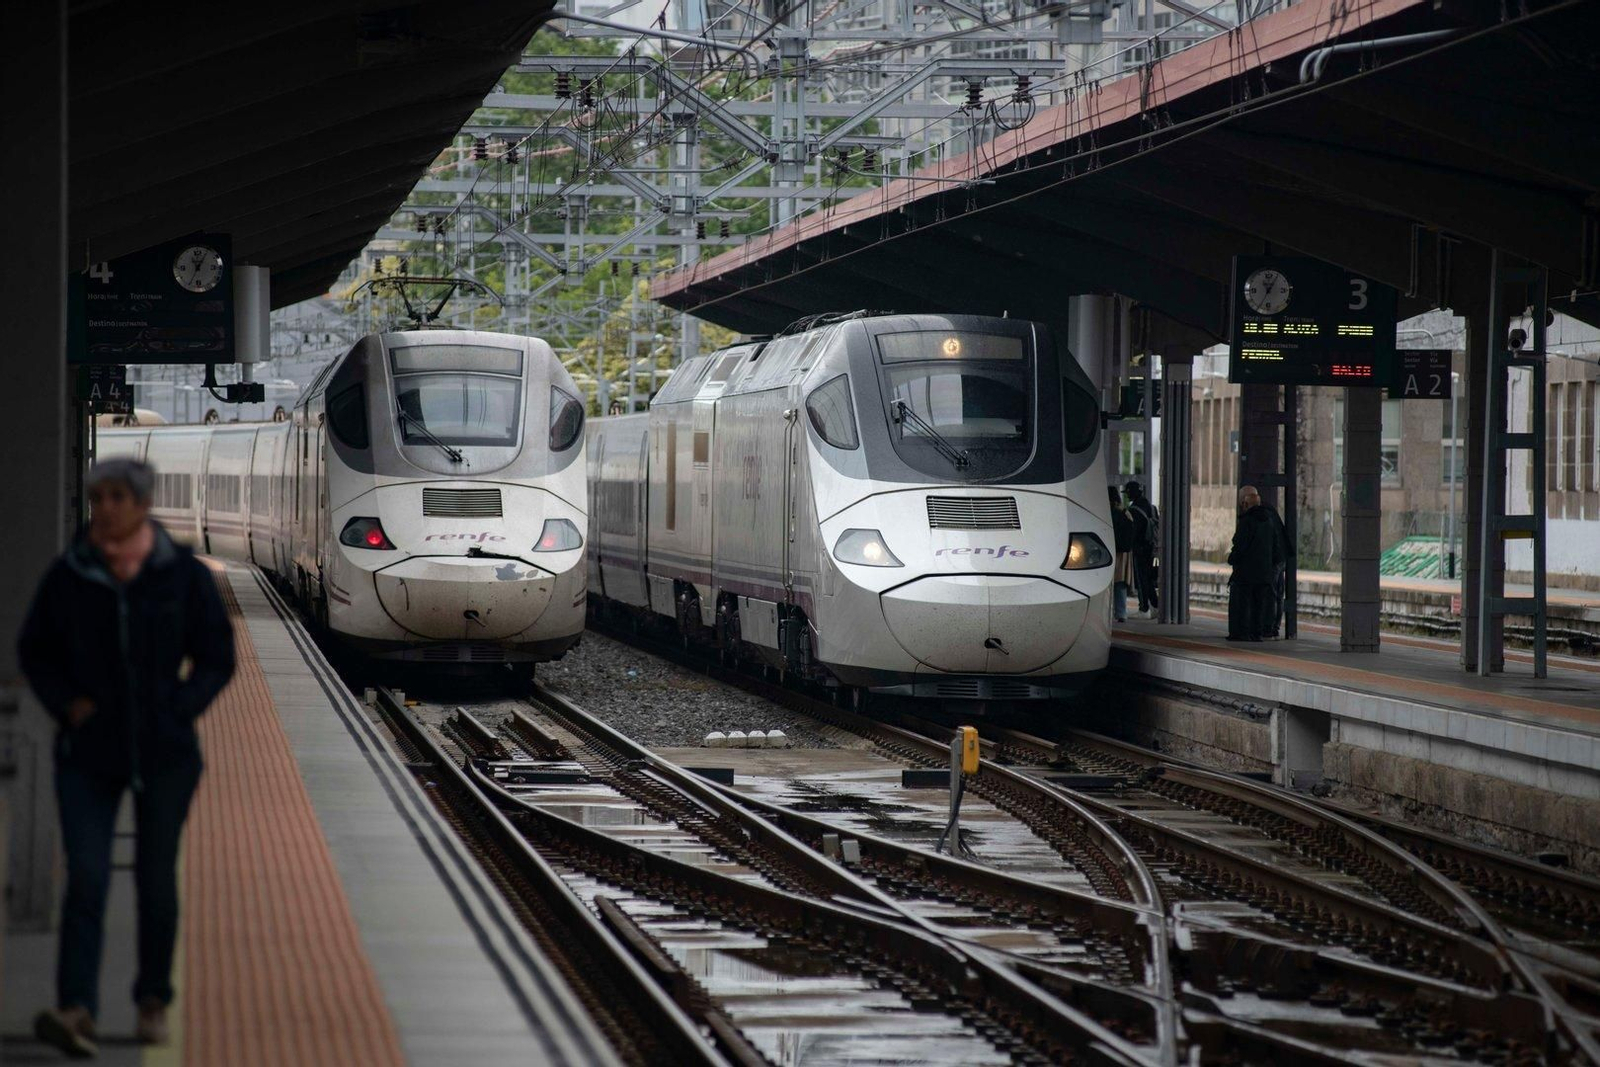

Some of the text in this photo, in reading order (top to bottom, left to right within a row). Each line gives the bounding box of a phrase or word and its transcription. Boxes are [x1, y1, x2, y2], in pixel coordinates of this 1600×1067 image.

[89, 260, 114, 285] 4
[1348, 278, 1368, 311] 3
[90, 382, 122, 400] A 4
[1404, 374, 1442, 396] A 2
[425, 532, 506, 543] renfe
[935, 544, 1030, 559] renfe
